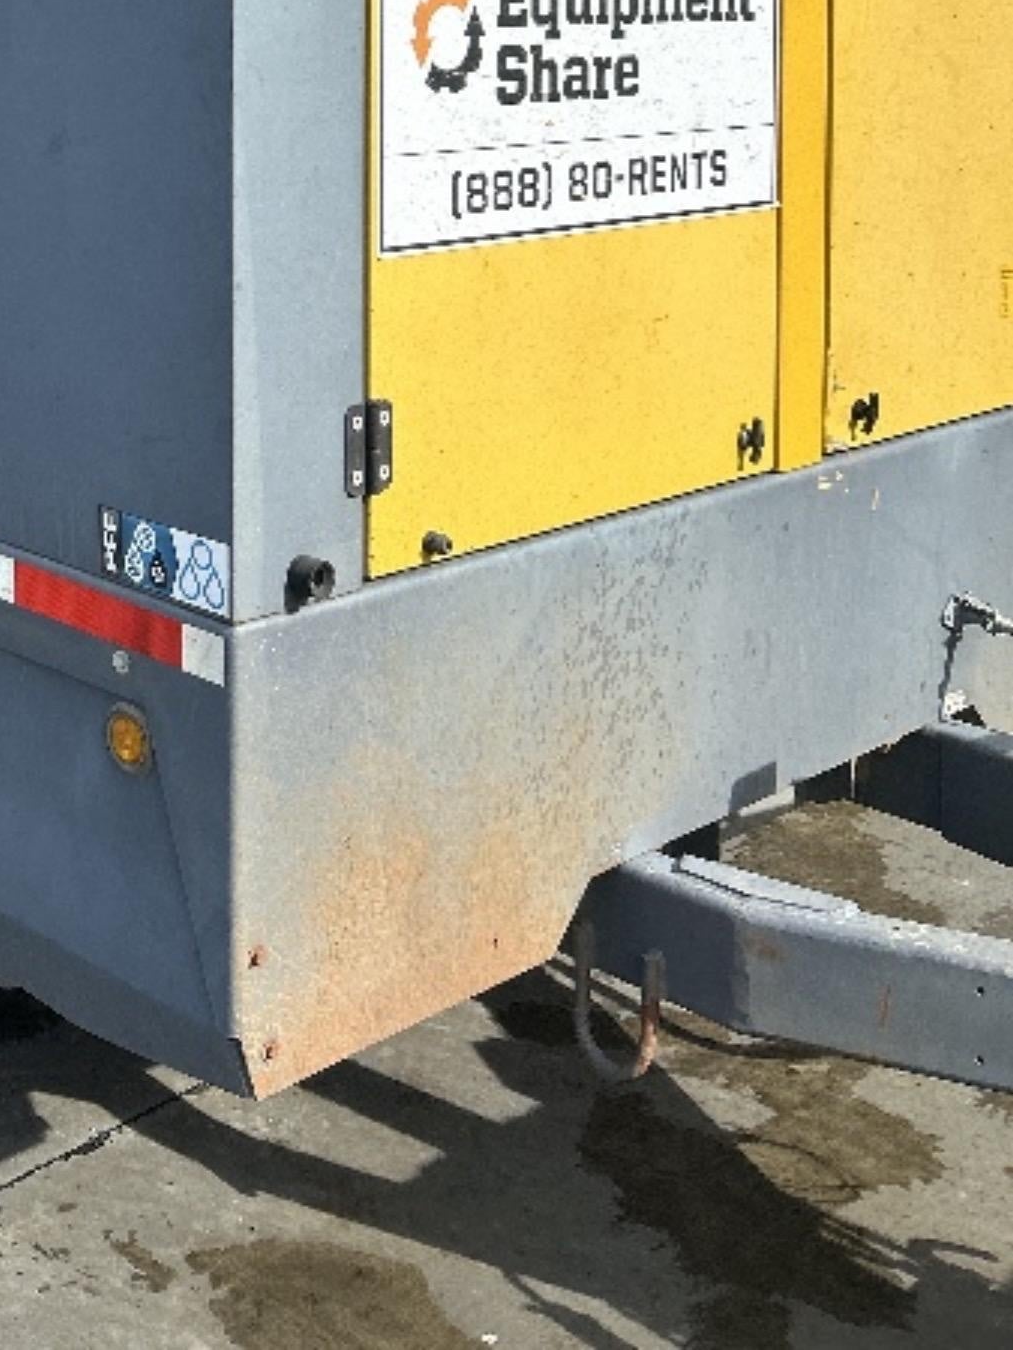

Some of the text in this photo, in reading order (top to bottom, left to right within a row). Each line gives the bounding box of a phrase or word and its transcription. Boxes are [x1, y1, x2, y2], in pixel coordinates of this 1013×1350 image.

[496, 45, 640, 106] Share
[451, 150, 727, 219] (888) 80-RENTS
